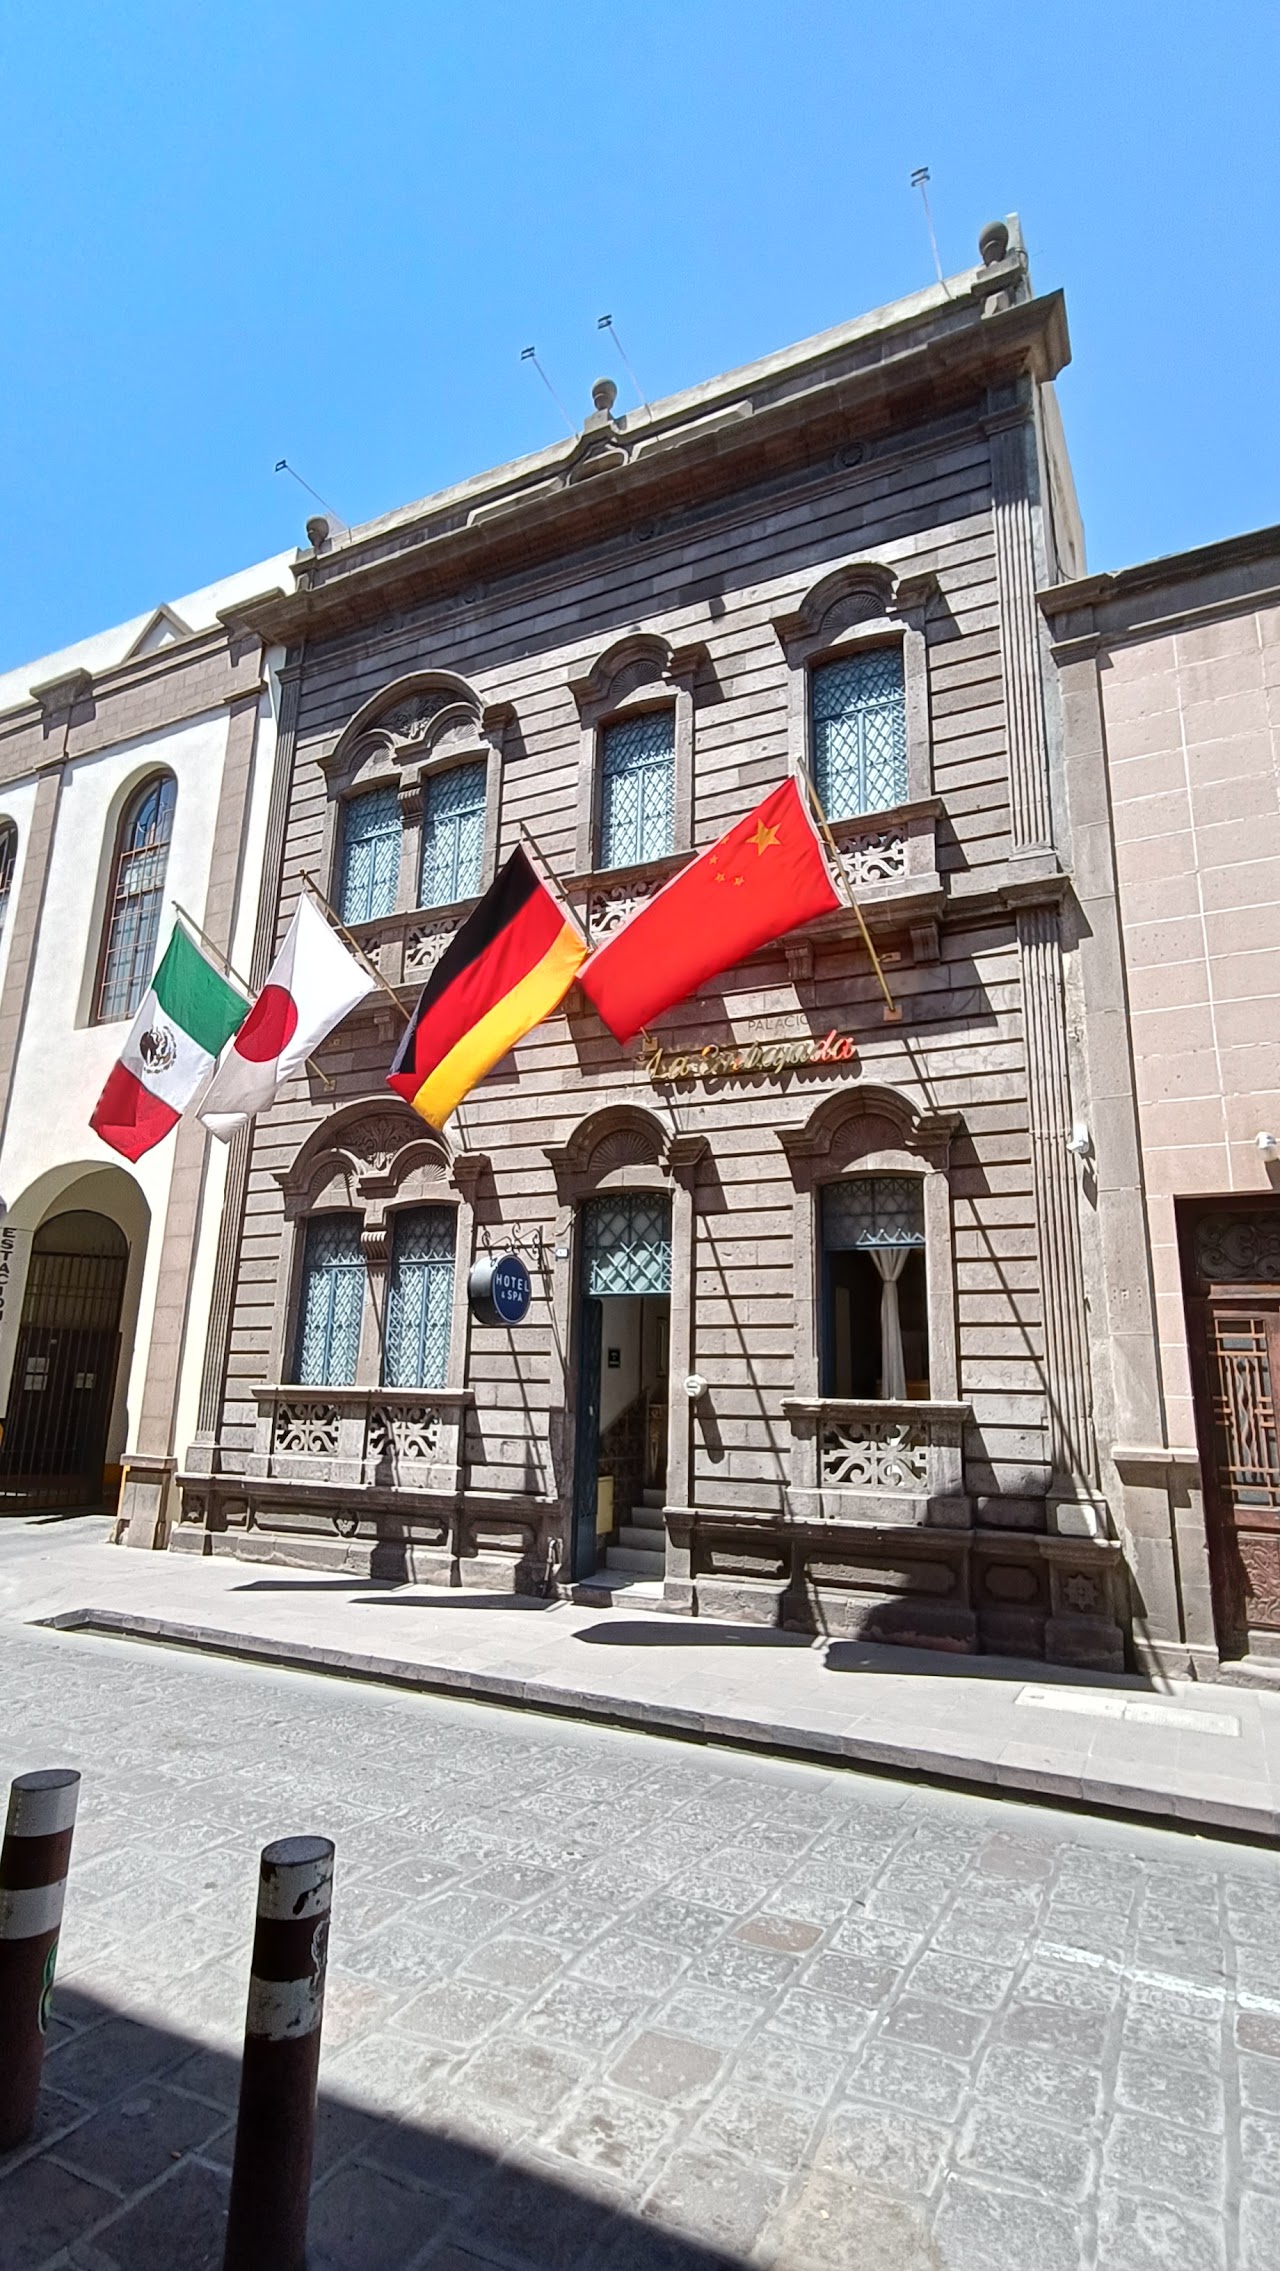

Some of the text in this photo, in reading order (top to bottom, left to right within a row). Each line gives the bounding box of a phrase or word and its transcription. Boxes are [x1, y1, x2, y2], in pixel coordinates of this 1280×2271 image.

[646, 1048, 689, 1080] La
[496, 1273, 530, 1292] HOTEL
[501, 1290, 523, 1302] & SPA
